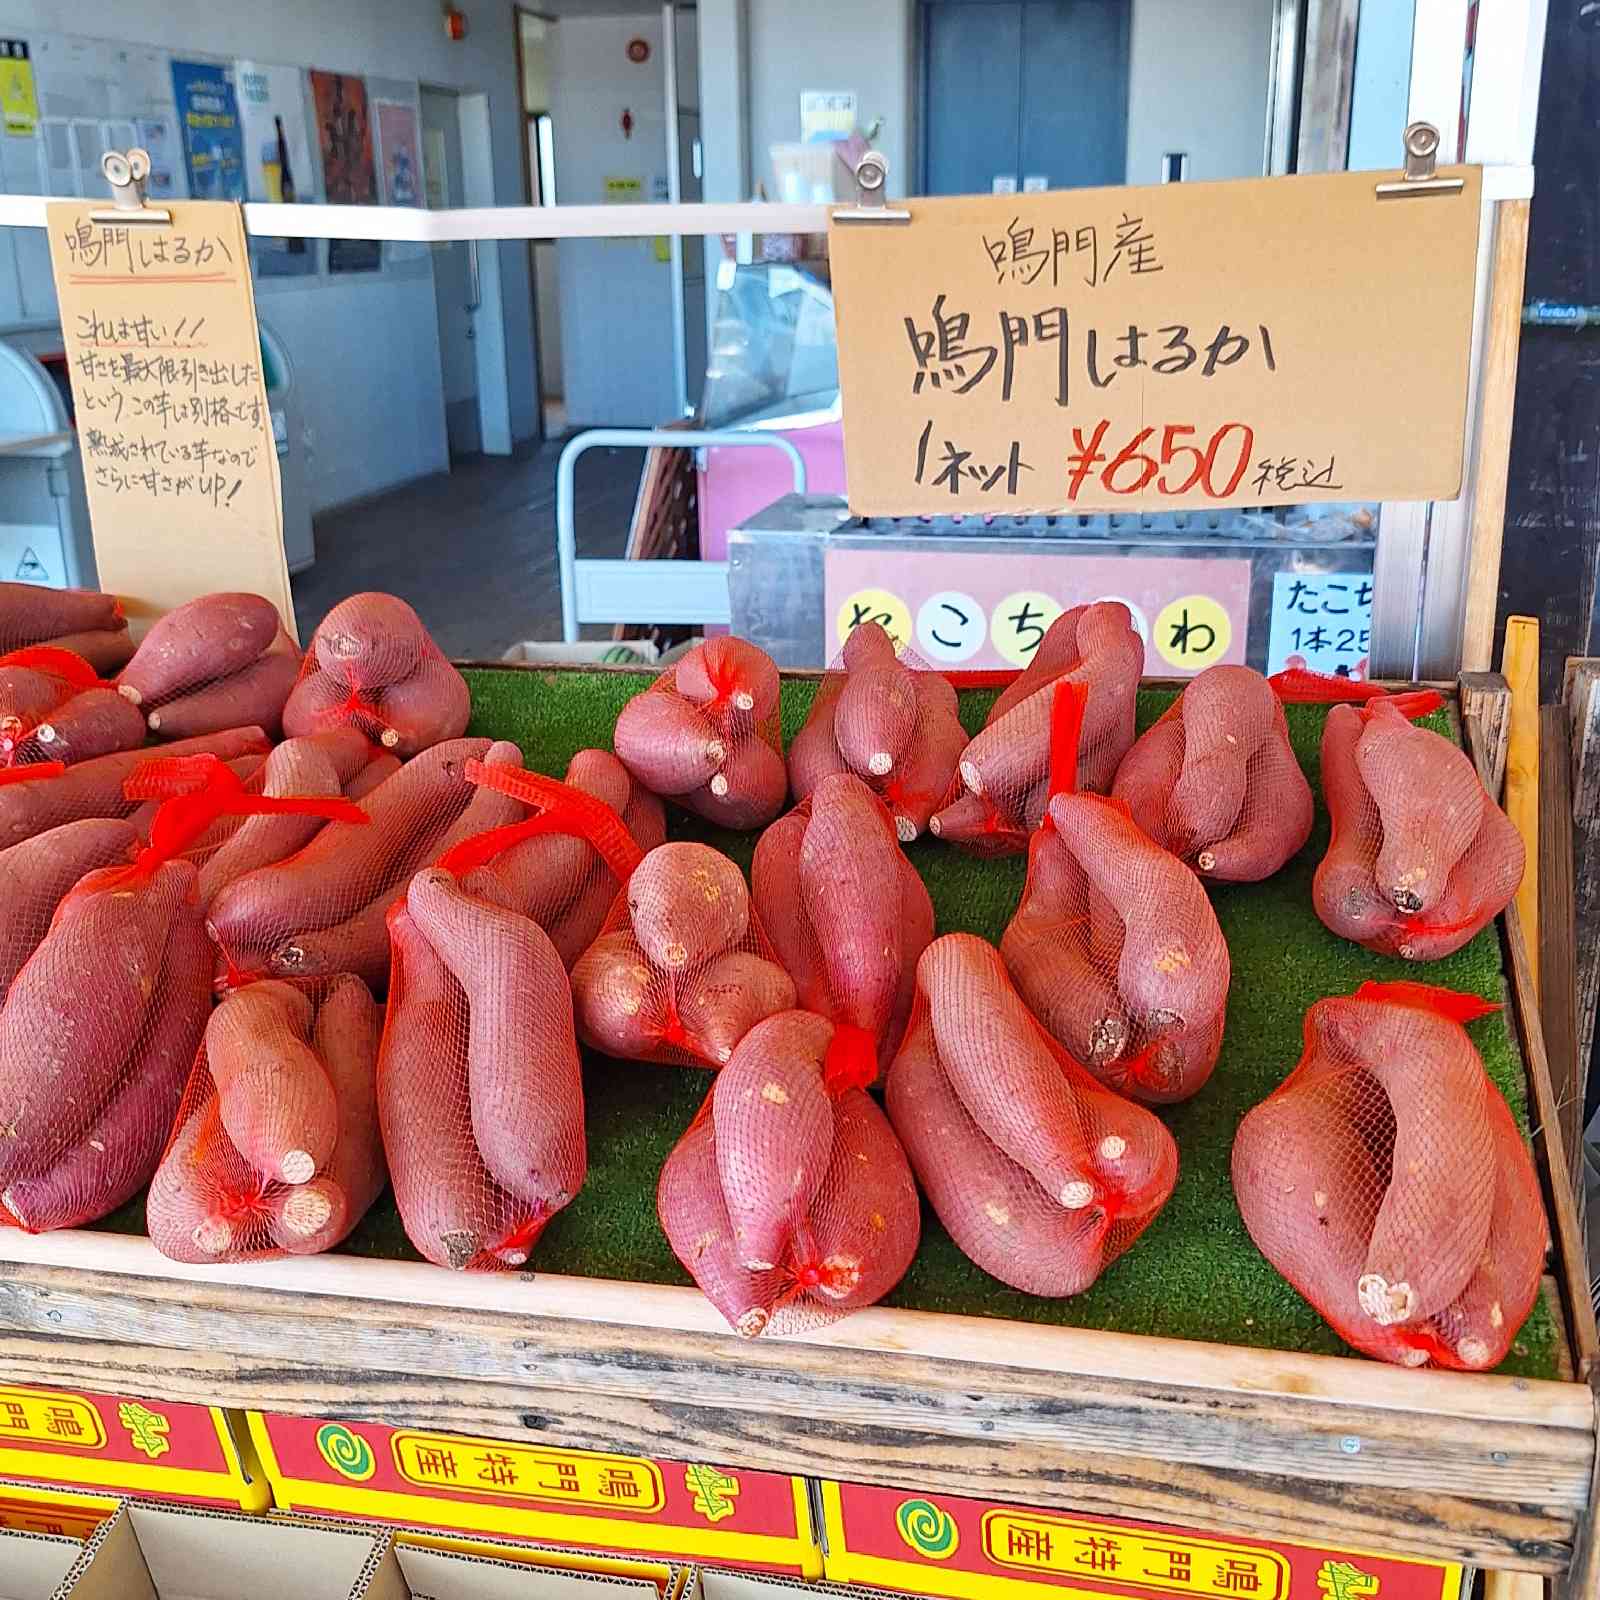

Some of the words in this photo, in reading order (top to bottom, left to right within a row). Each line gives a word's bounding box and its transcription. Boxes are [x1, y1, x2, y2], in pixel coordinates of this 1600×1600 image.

[64, 217, 233, 274] 鳴門はるか
[981, 211, 1164, 288] 鳴門産
[76, 350, 261, 393] 甘さを最大限引き出した
[903, 294, 1278, 407] 鳴門はるか
[914, 419, 1036, 495] 1ネット
[1067, 418, 1254, 502] ¥650
[1251, 455, 1344, 497] 税込
[415, 1444, 642, 1500] 鳴門特産
[1007, 1523, 1264, 1592] 鳴門特産
